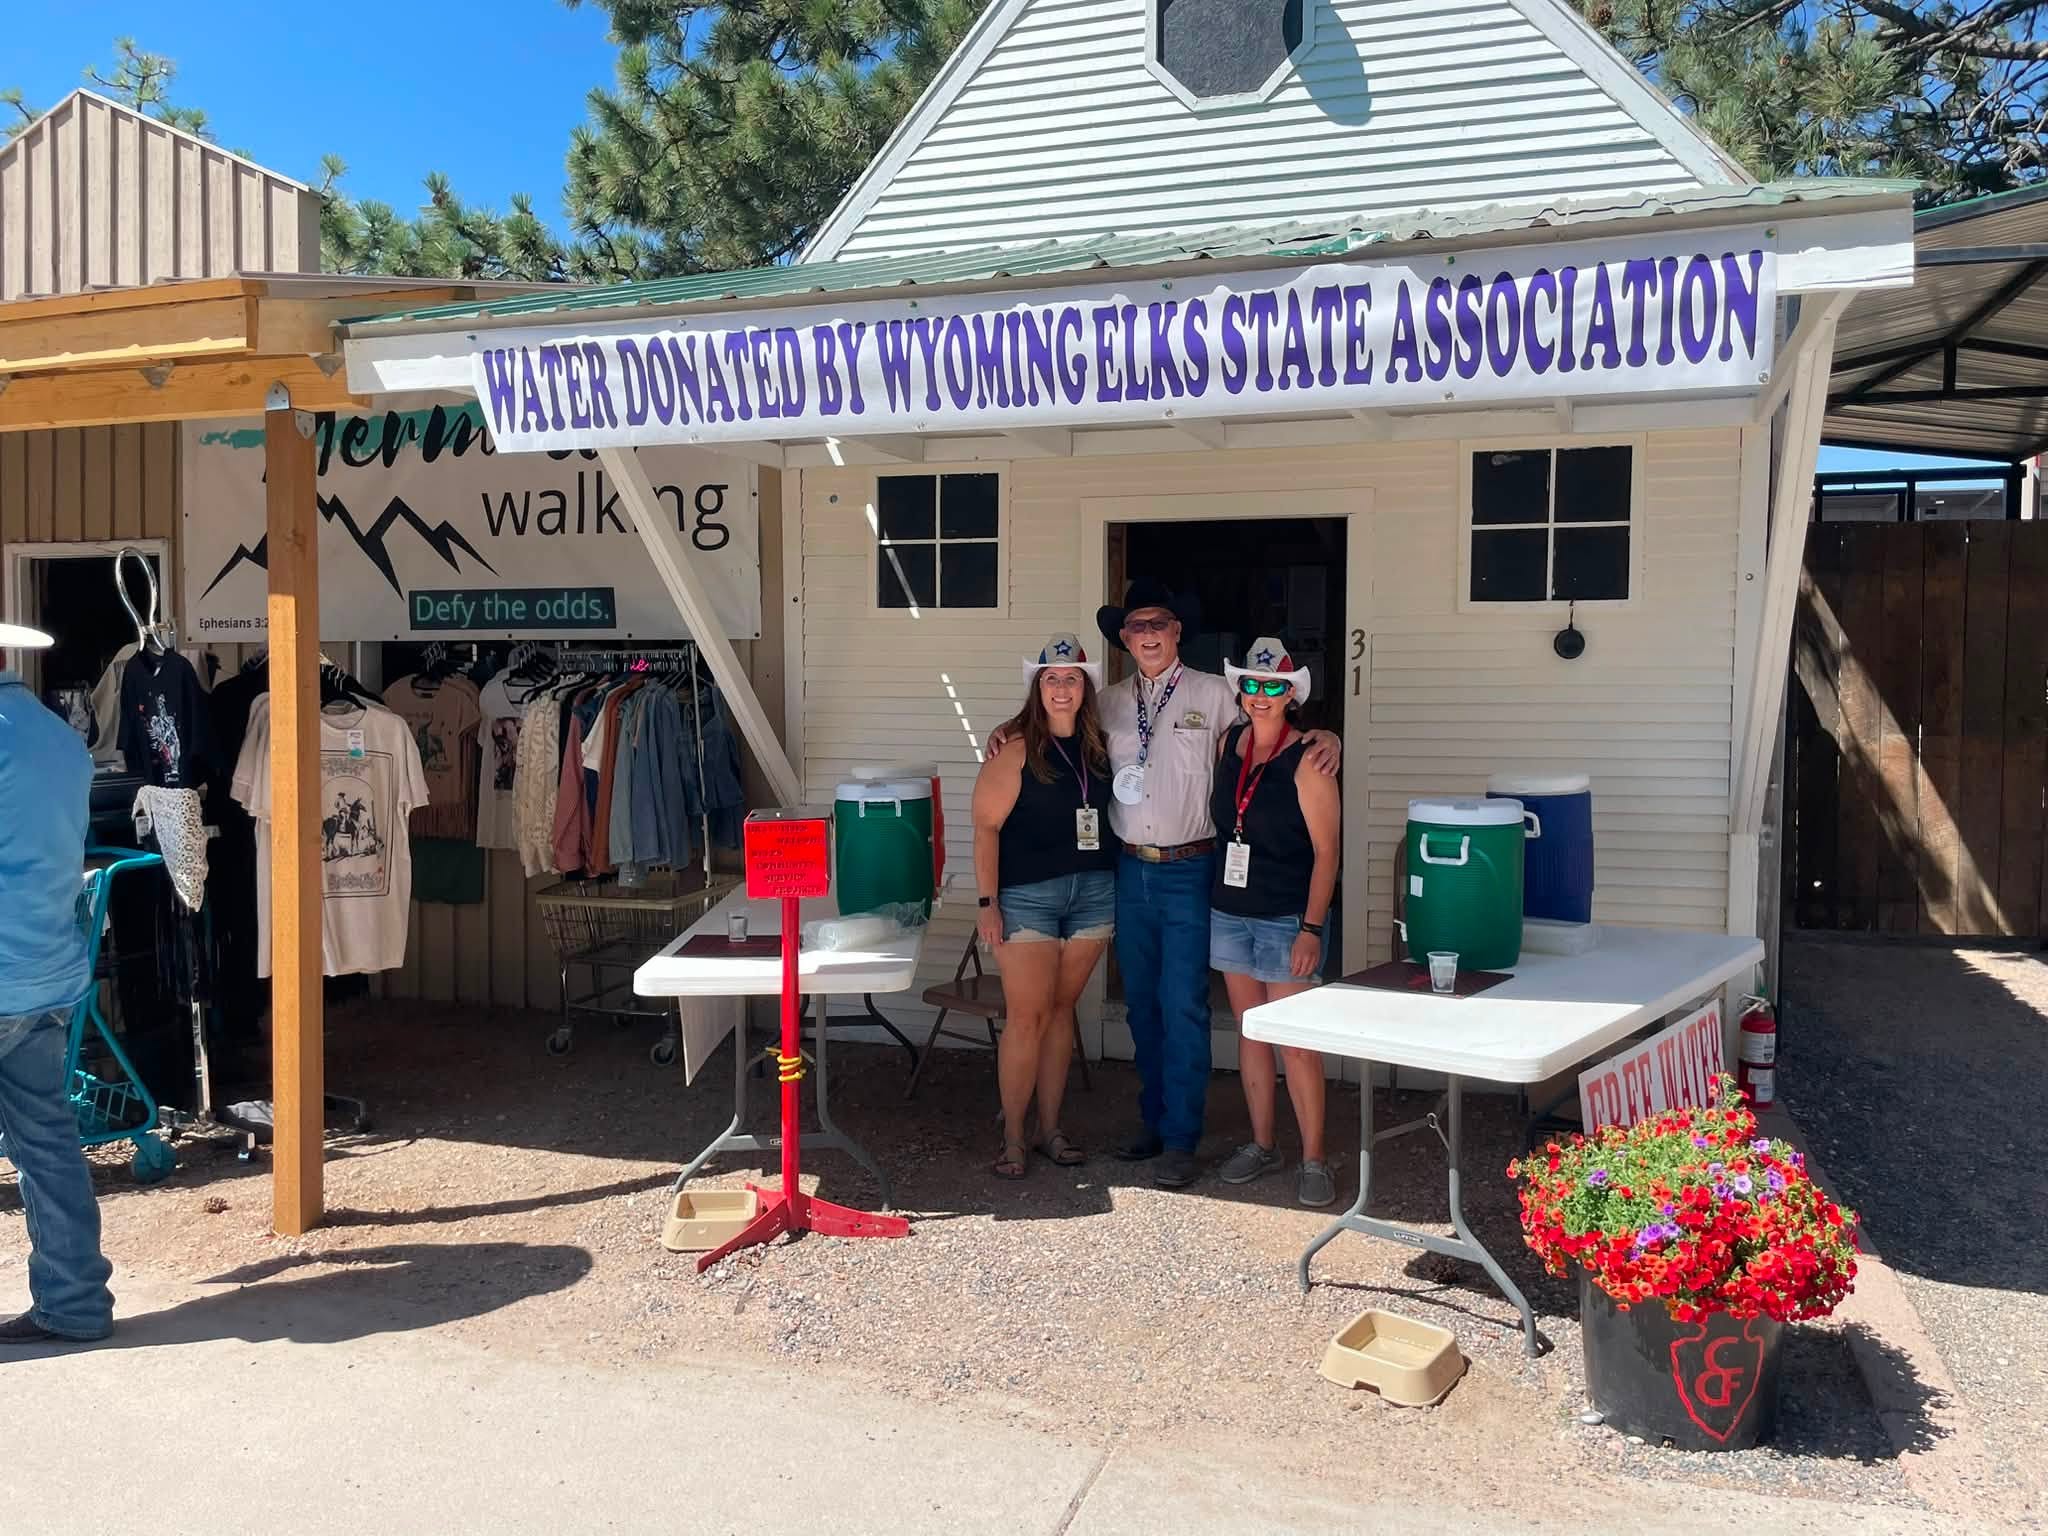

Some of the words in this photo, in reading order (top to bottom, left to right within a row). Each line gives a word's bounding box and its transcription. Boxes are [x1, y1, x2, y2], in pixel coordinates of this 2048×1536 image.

[482, 342, 618, 434] WATER
[617, 326, 806, 428] DONATED
[813, 321, 866, 416] BY
[876, 308, 1088, 414] WYOMING
[1095, 298, 1208, 405] ELKS
[1220, 284, 1373, 396] STATE
[1386, 250, 1763, 385] ASSOCIATION
[481, 471, 730, 551] walkng
[199, 617, 252, 632] Ephesians
[415, 594, 476, 626] Defy
[482, 593, 527, 621] the
[534, 592, 610, 621] odds.
